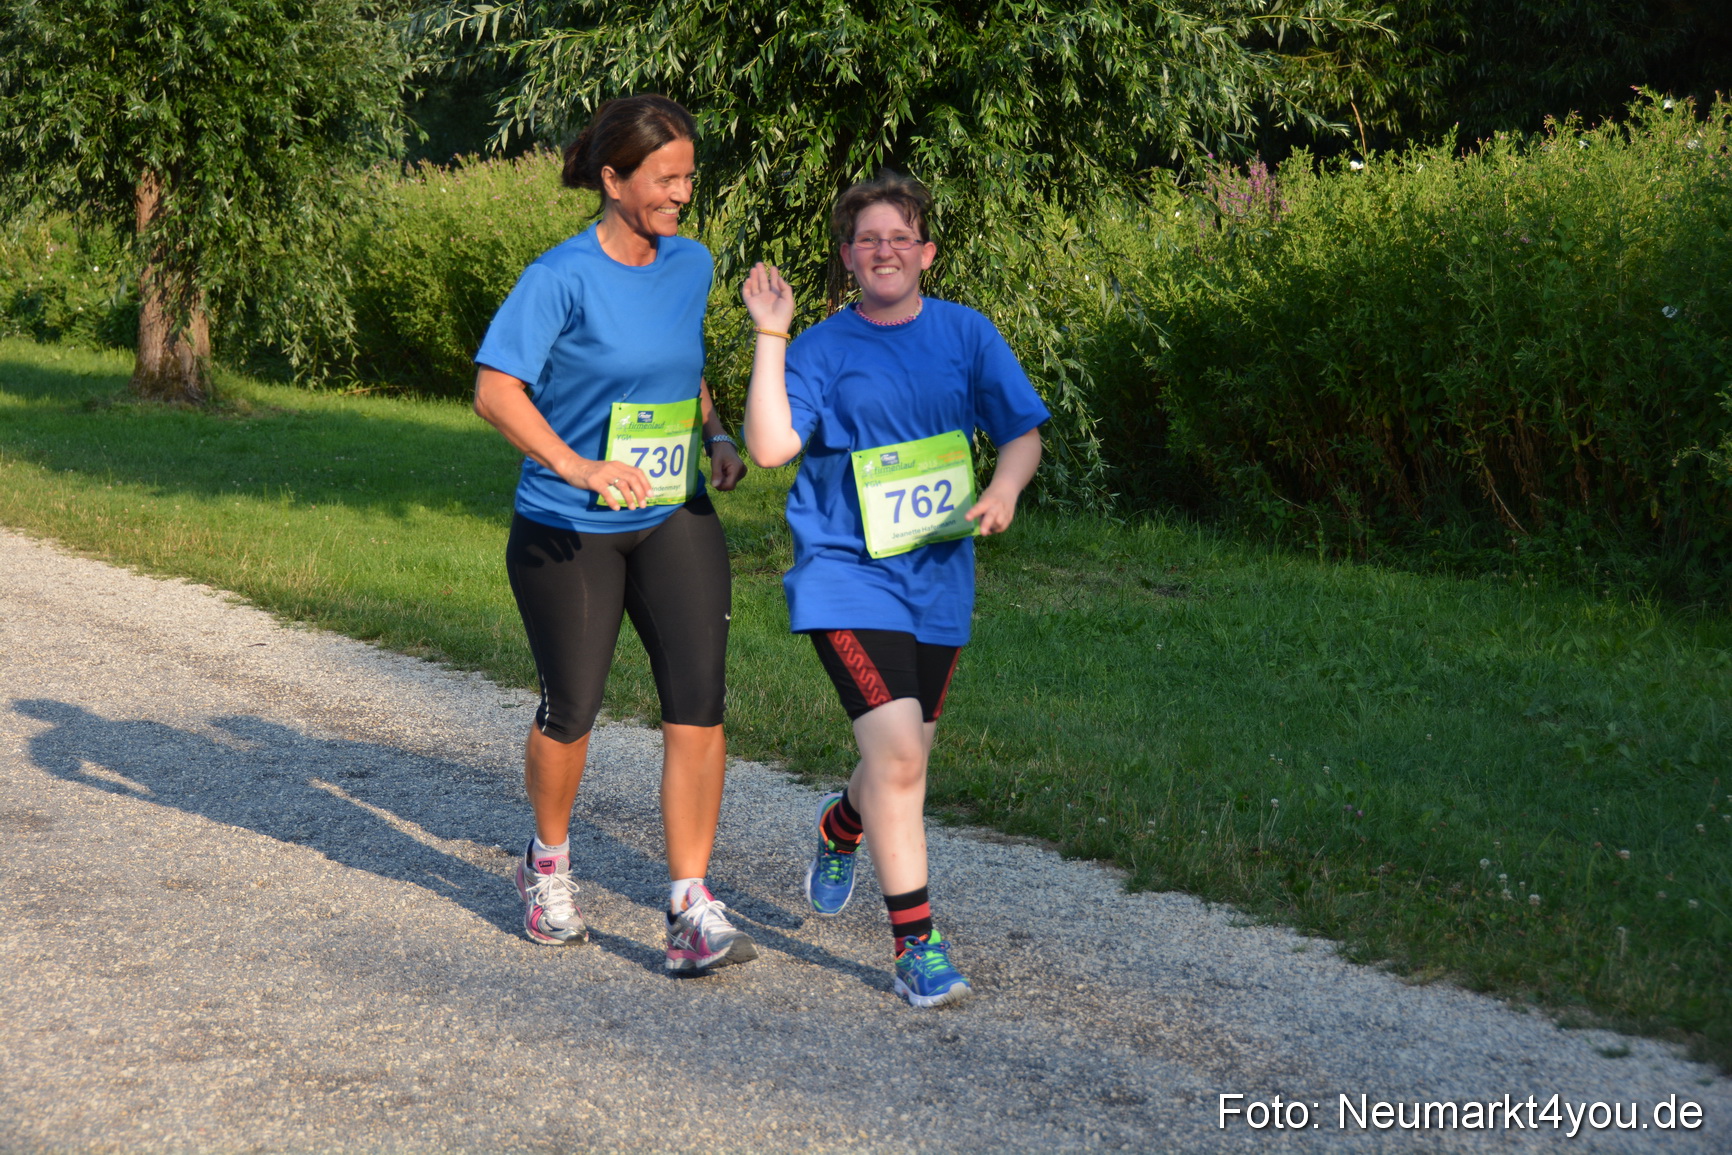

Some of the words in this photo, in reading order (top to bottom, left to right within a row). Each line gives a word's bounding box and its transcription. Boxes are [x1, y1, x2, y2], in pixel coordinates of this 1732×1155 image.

[630, 444, 685, 478] 730
[651, 484, 681, 492] indenmayr
[885, 479, 955, 524] 762
[891, 528, 921, 540] Jeanette
